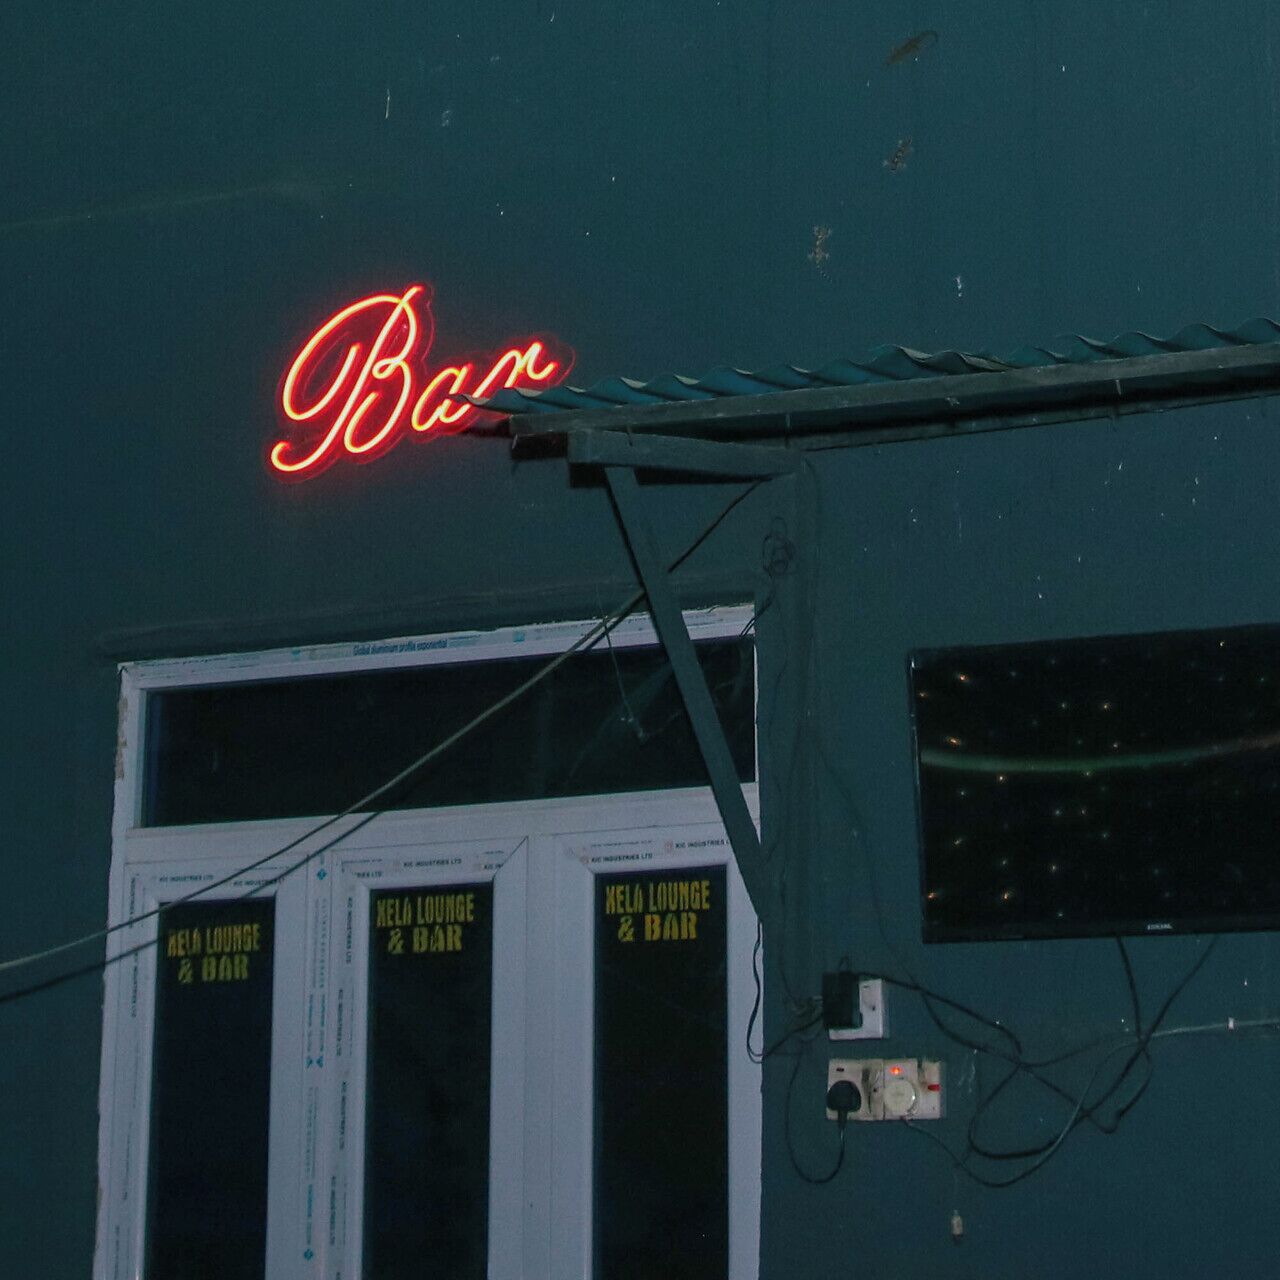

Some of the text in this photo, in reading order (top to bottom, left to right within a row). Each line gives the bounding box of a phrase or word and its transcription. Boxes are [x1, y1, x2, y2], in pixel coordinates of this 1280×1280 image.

[270, 284, 558, 473] Bar
[417, 893, 475, 925] LOUNGE
[649, 879, 711, 912] LOUNGE
[206, 923, 261, 954] LOUNGE
[388, 925, 463, 955] & BAR
[618, 912, 697, 942] & BAR
[178, 953, 249, 984] & BAR
